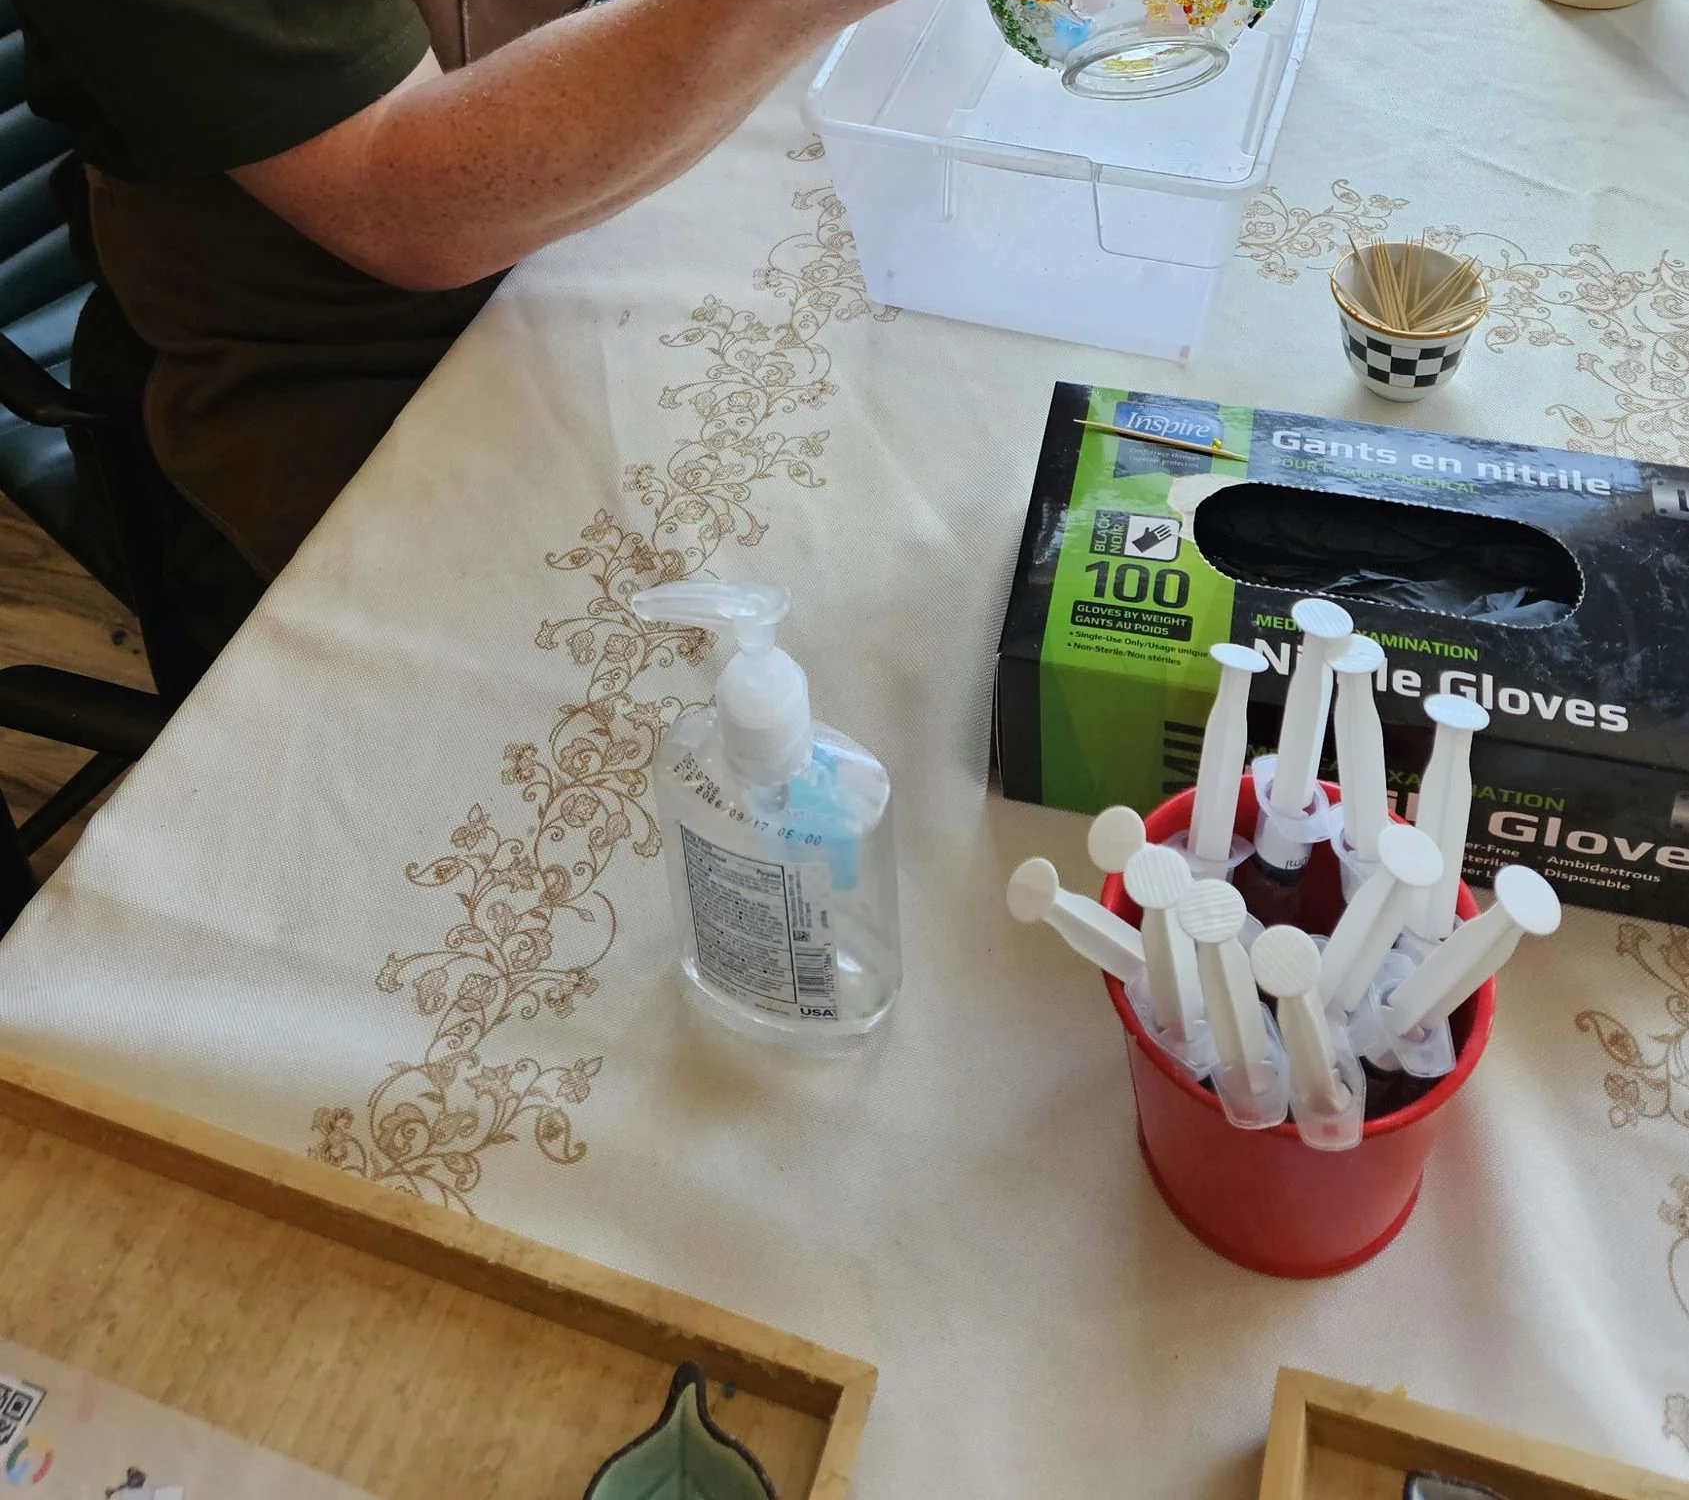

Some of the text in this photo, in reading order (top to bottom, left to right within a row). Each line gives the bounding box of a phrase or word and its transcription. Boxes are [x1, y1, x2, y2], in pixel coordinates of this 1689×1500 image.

[1126, 411, 1211, 438] Inspire
[1272, 430, 1612, 496] Gants en nitrile
[1094, 510, 1112, 552] BLACK
[1109, 523, 1123, 554] NOIR
[1085, 560, 1191, 609] 100
[1075, 615, 1169, 636] GANTS AU POIDS
[1077, 604, 1187, 627] GLOVES BY WEIGHT
[1075, 630, 1122, 645] Single-Use
[1177, 647, 1209, 660] unique
[1440, 670, 1629, 732] Gloves
[1487, 811, 1689, 871] Glove
[1544, 868, 1631, 891] Disposable
[1546, 855, 1661, 883] Ambidextrous
[800, 1007, 834, 1018] USA
